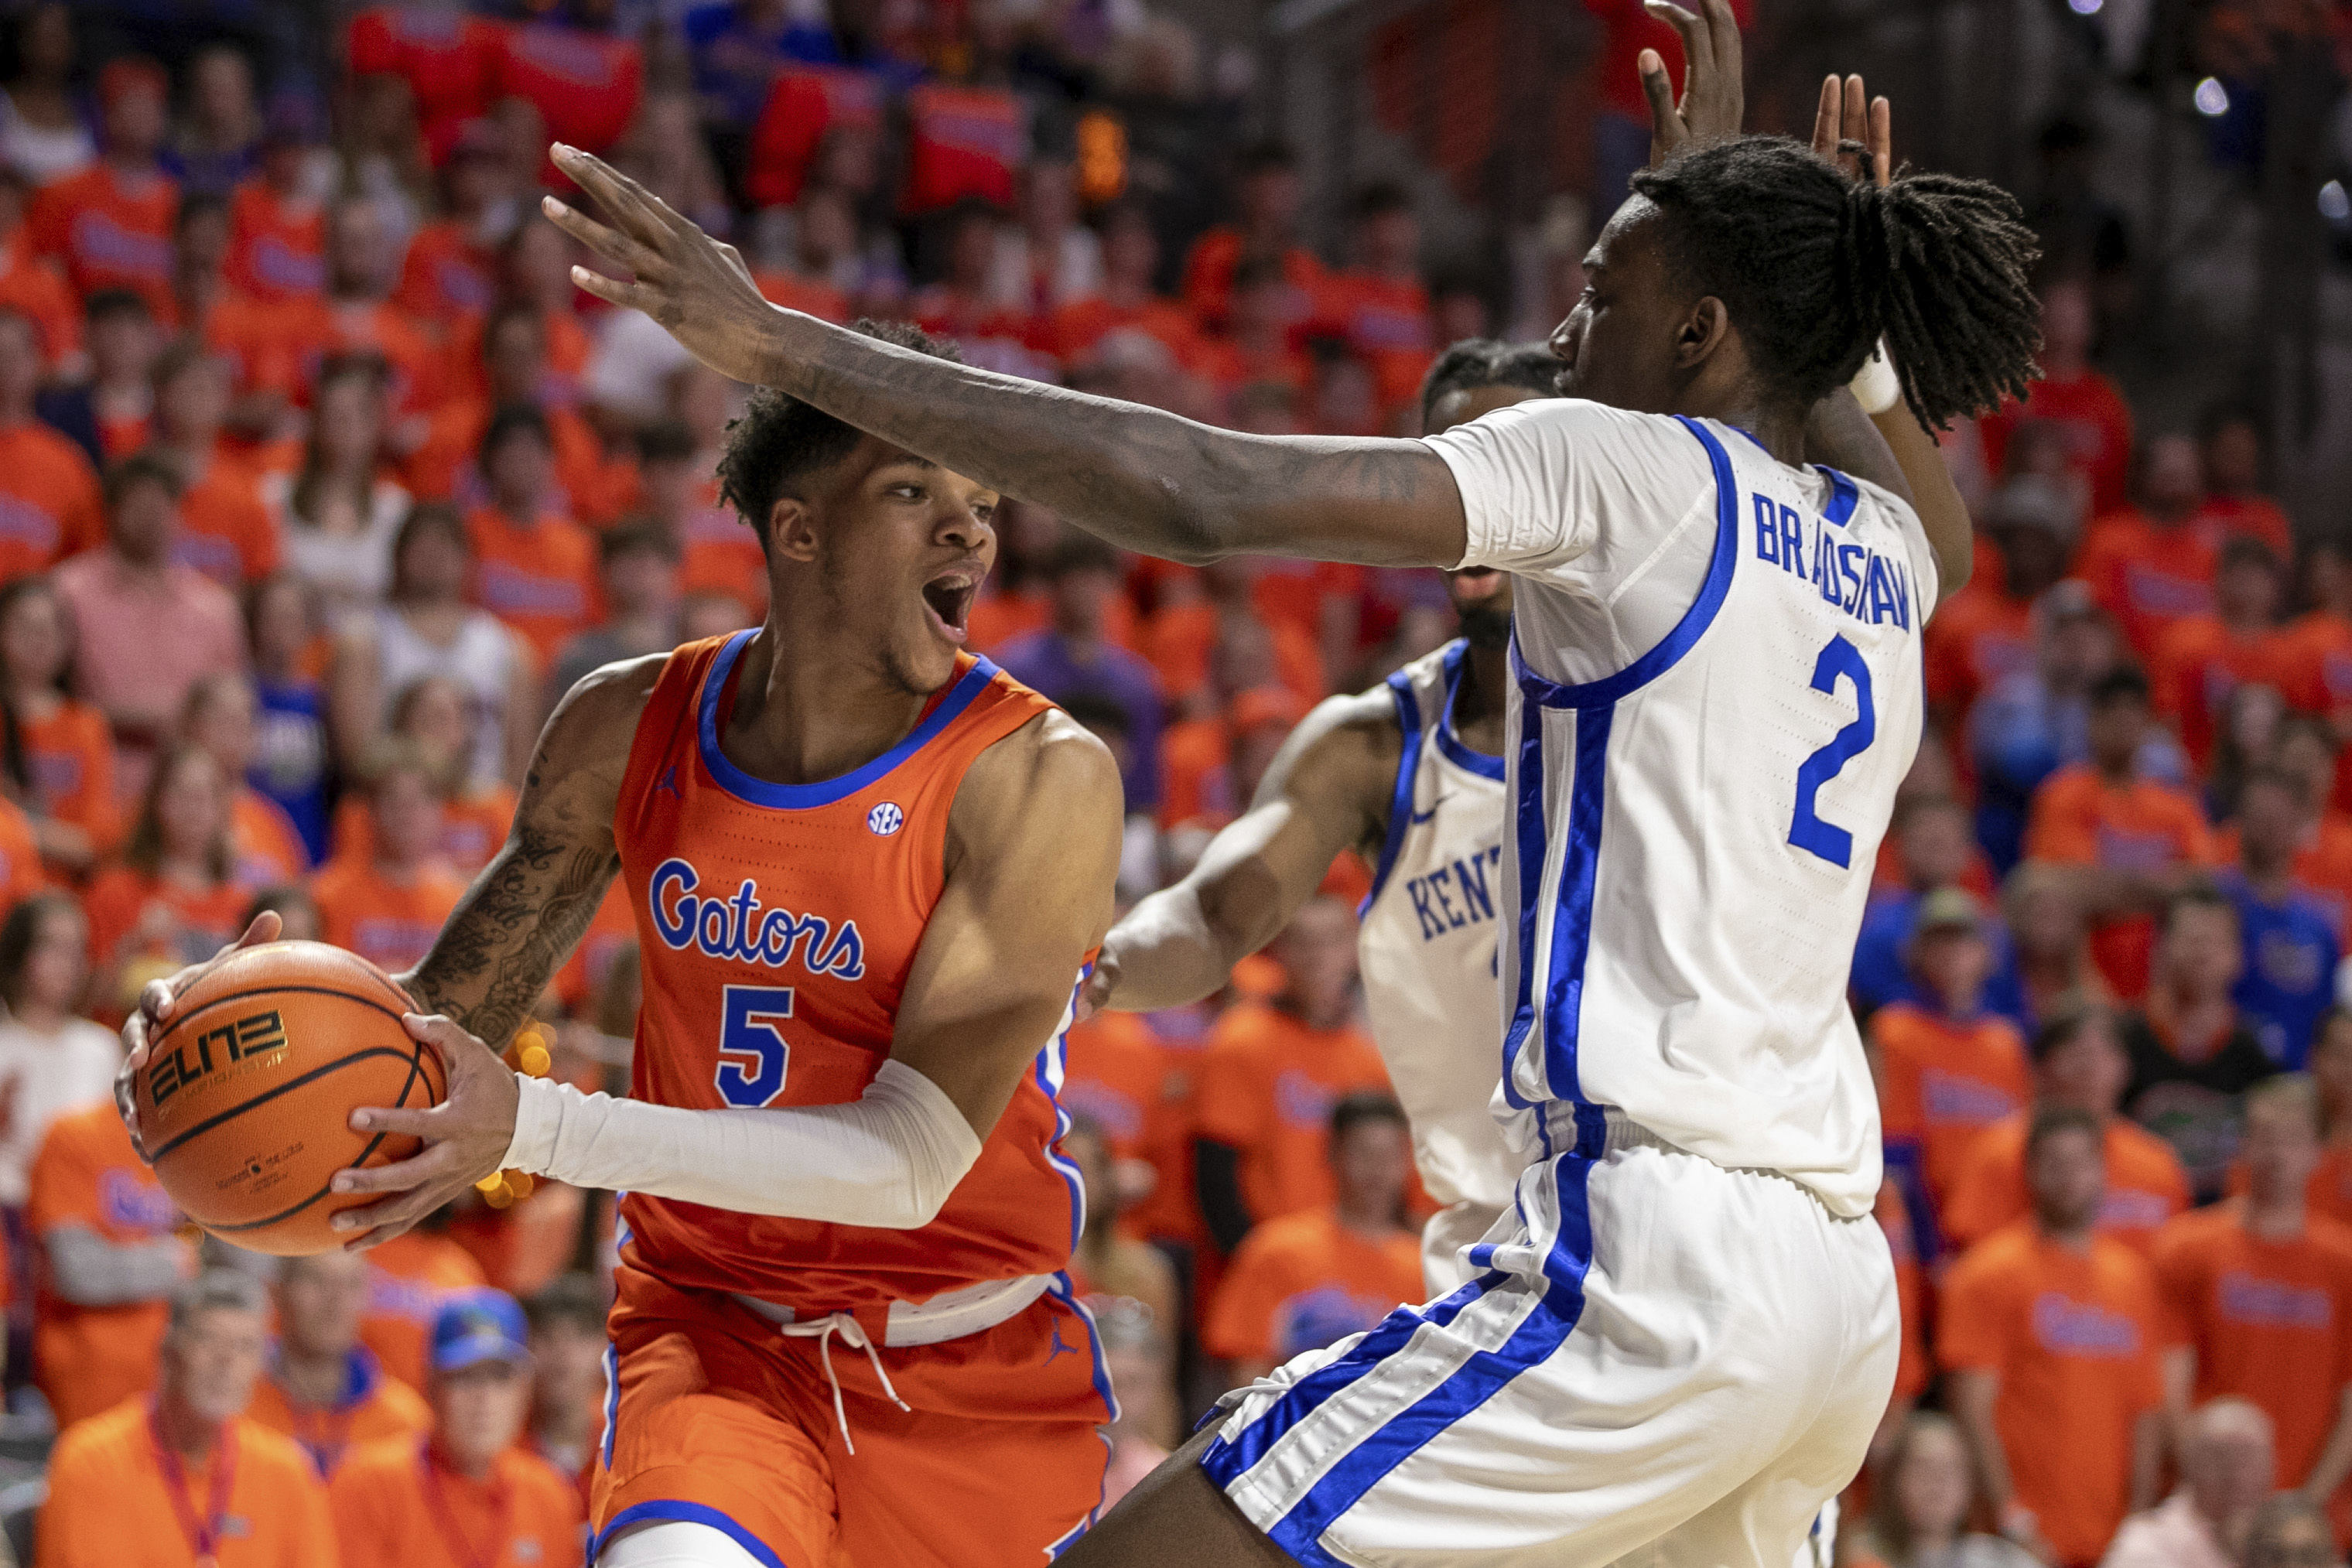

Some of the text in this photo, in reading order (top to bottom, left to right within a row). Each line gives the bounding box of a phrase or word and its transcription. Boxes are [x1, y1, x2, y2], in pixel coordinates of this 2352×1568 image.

[1787, 630, 1876, 870] 2
[868, 802, 903, 835] SEC
[648, 857, 866, 982] Gators
[149, 1009, 287, 1107] ELITE
[714, 983, 795, 1109] 5
